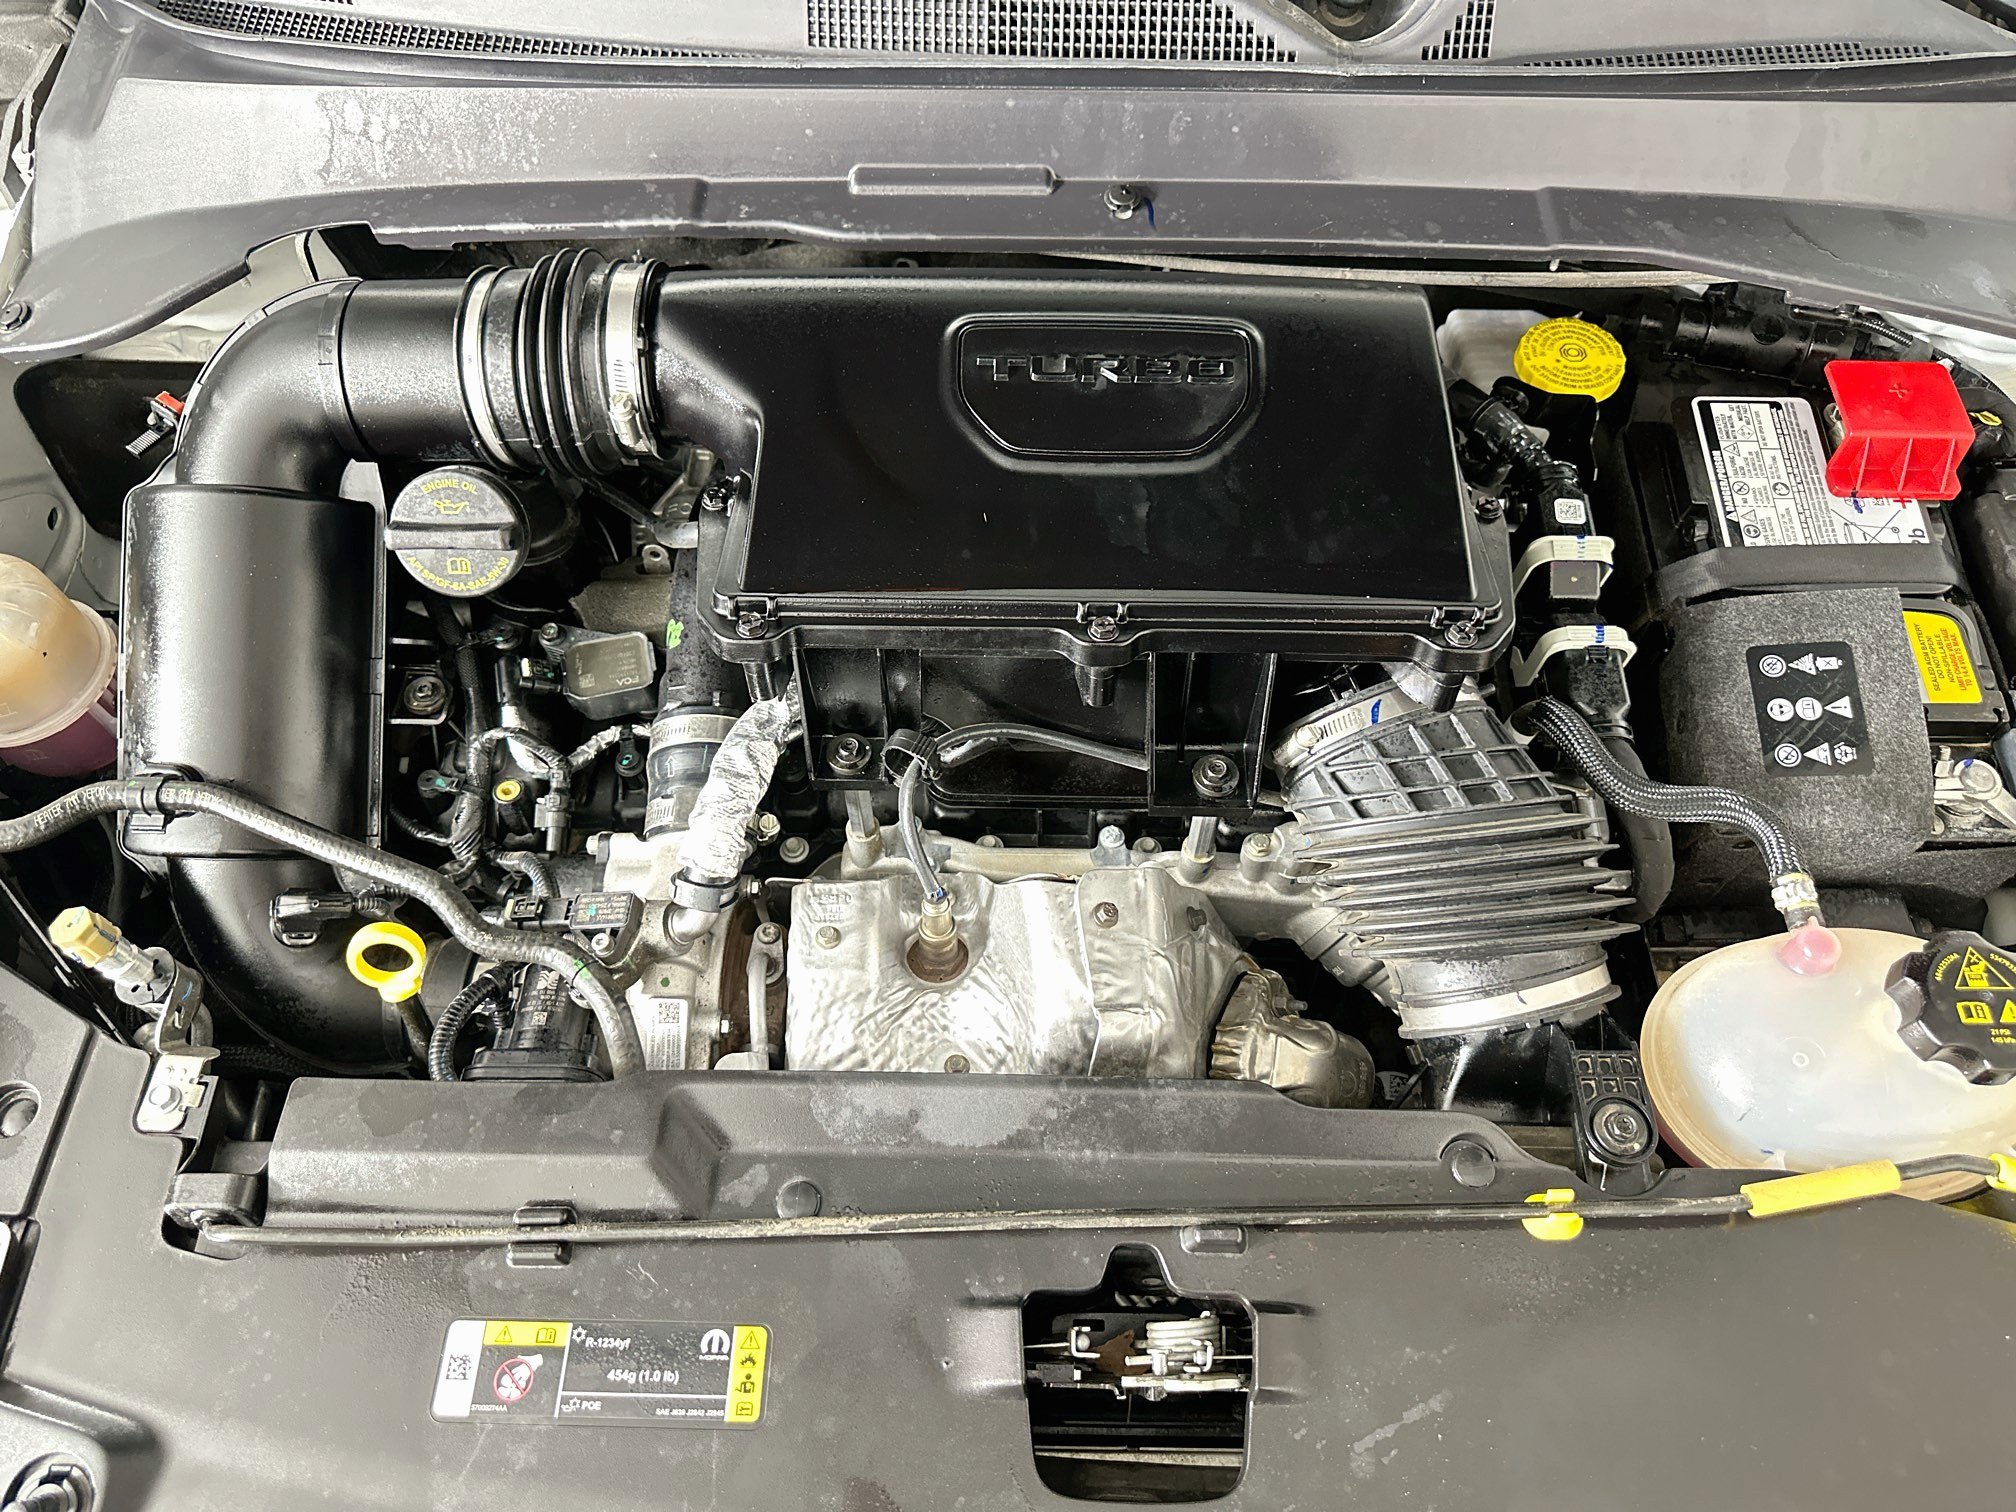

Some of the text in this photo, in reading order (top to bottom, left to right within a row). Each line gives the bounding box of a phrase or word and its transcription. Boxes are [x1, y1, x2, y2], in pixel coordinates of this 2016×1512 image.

[976, 356, 1235, 385] TURBO
[421, 479, 478, 494] ENGINE OIL
[1712, 450, 1734, 512] DANGER/POISON
[407, 556, 423, 573] API
[1914, 624, 1941, 691] SEALED AGM BATTERY
[1926, 635, 1945, 679] DO NOT OPEN!
[1934, 634, 1955, 683] NON-SPILLABLE
[1940, 628, 1967, 691] LIMIT CHARGE VOLTAGE
[1954, 648, 1965, 665] VOLTS
[616, 675, 640, 686] FCA
[34, 803, 63, 827] HEATER
[585, 1337, 631, 1351] R-1234yf
[607, 1369, 680, 1385] 454g (1.0 lb)
[582, 1401, 602, 1411] POE
[655, 1408, 670, 1416] SAE
